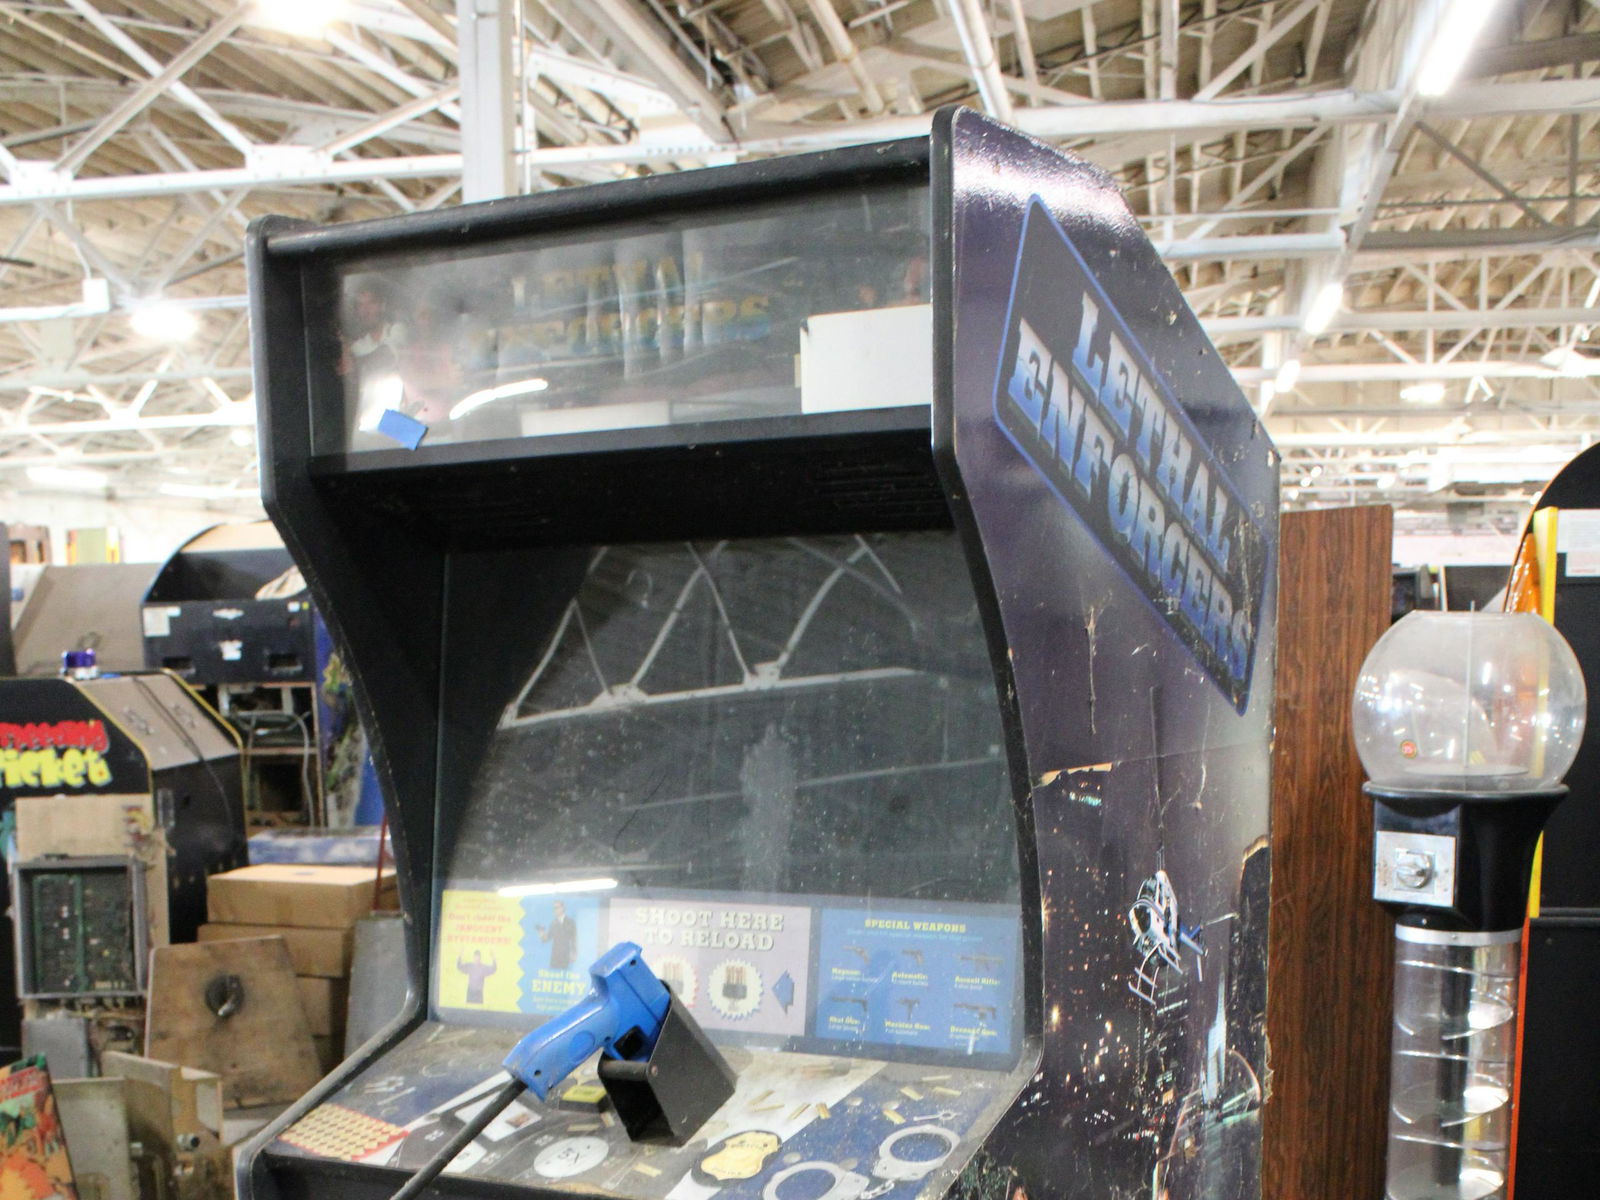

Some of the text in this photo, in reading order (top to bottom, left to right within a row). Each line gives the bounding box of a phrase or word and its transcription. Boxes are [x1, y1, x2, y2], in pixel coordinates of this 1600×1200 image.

[1072, 290, 1232, 576] LETHAL
[1008, 315, 1252, 683] ENFORCERS
[635, 906, 785, 932] SHOOT HERE
[864, 918, 967, 934] SPECIAL WEAPONS
[643, 927, 775, 951] TO RELOAD
[532, 978, 588, 996] ENEMY
